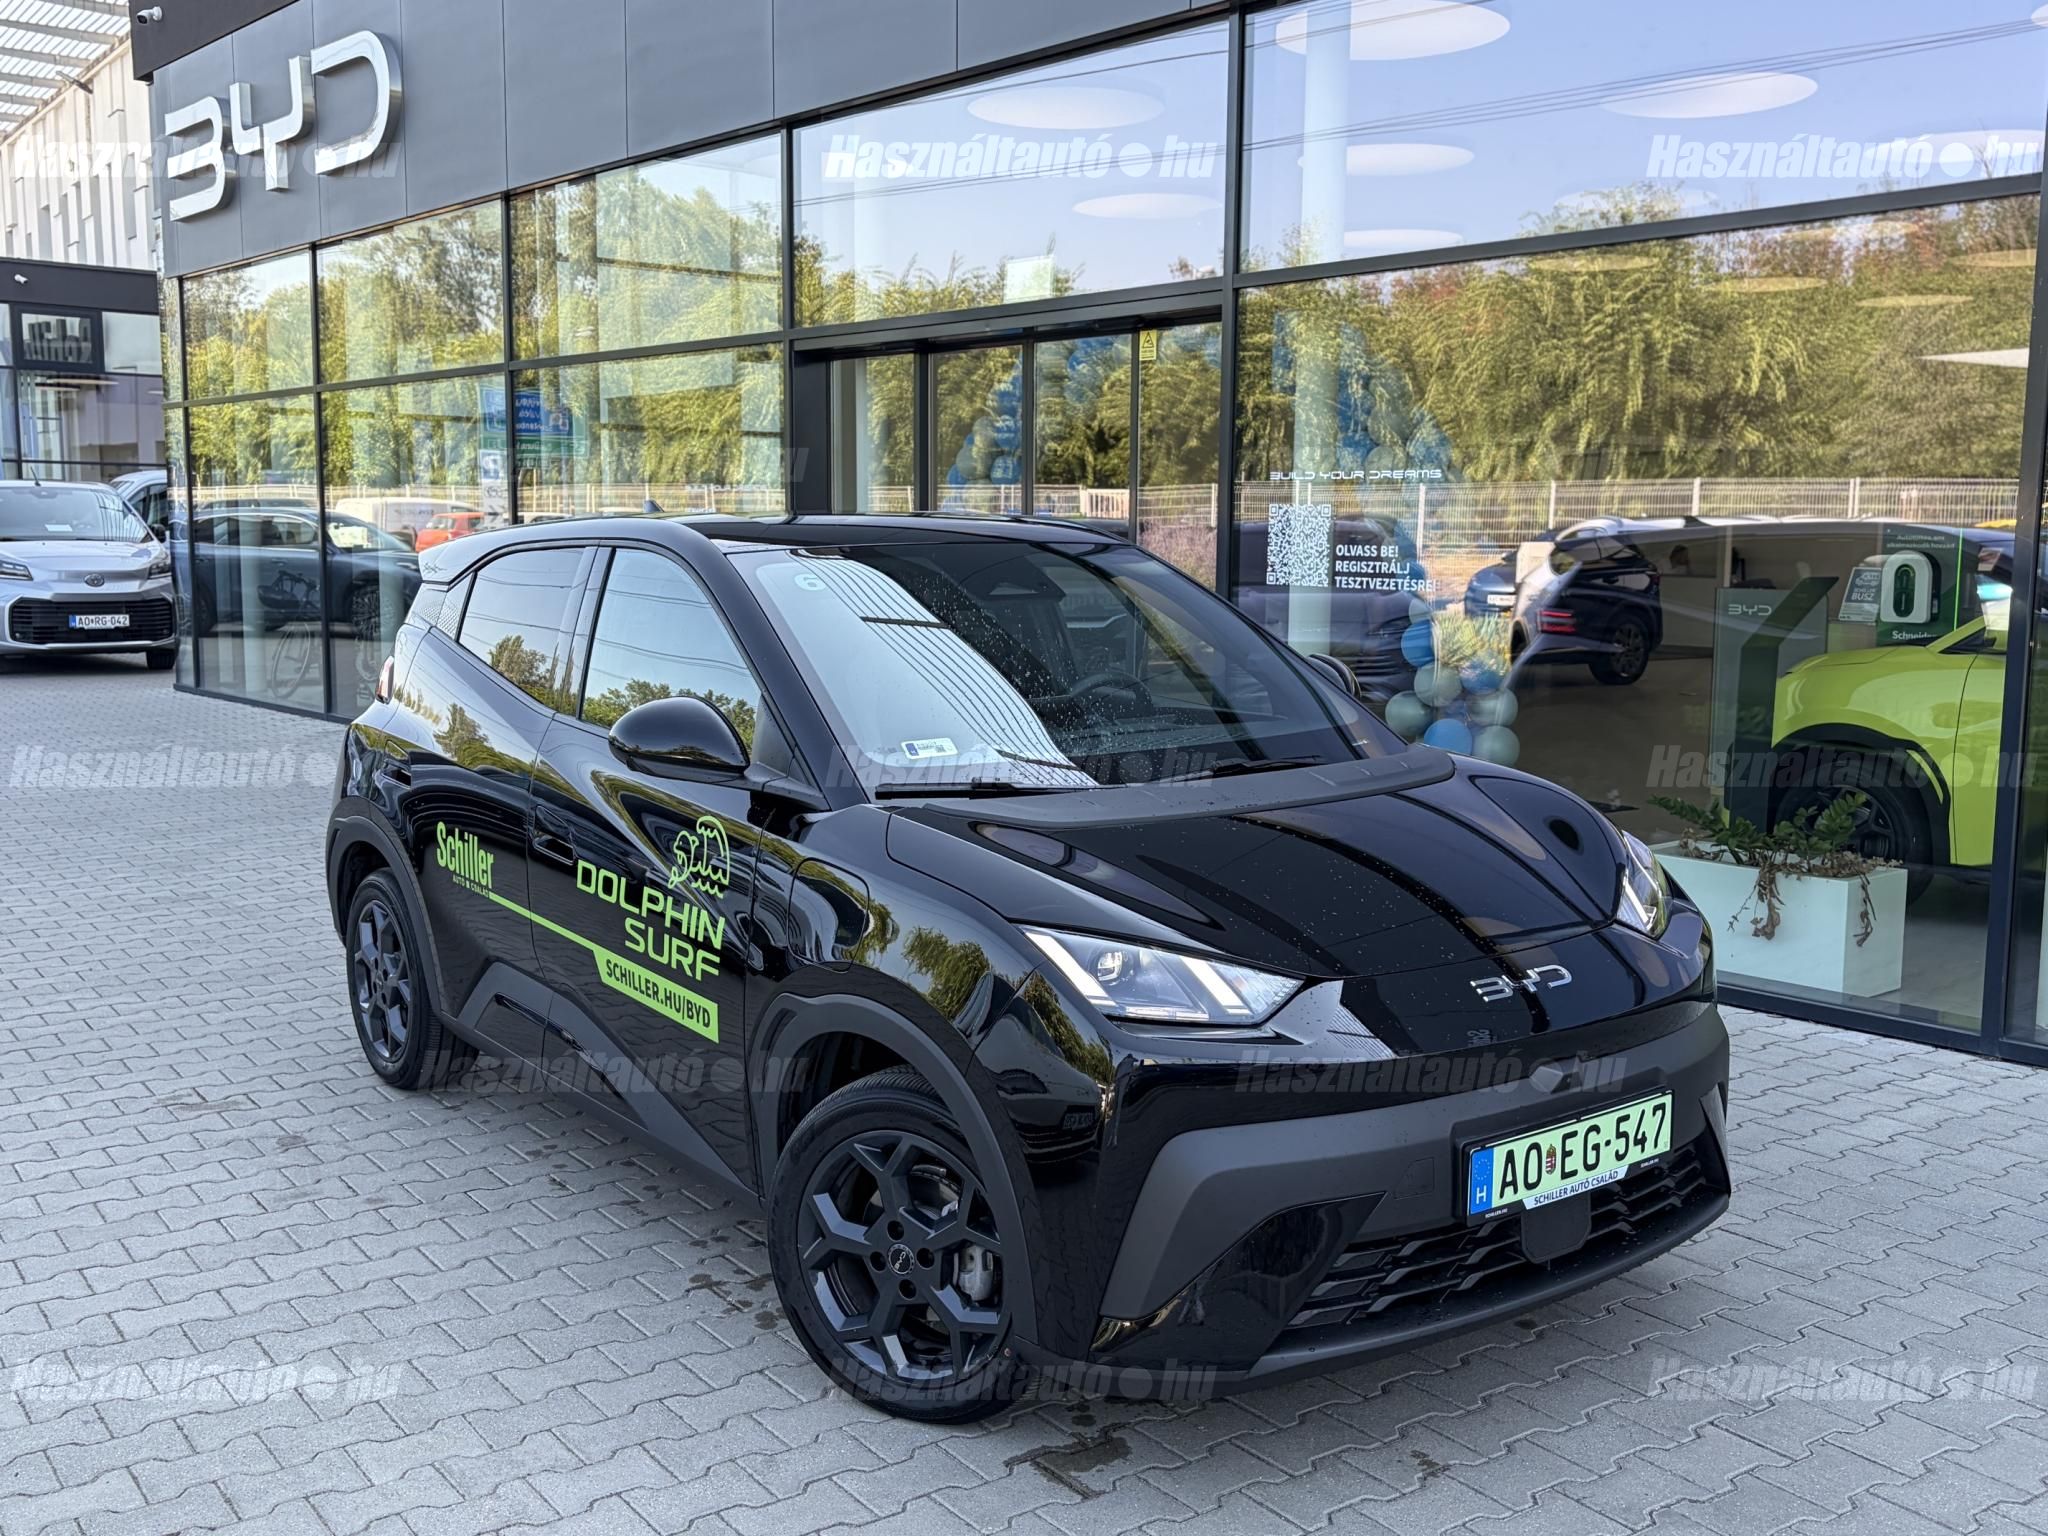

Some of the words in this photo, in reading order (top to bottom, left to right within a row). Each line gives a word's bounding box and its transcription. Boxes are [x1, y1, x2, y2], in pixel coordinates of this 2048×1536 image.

[164, 30, 402, 222] BYD
[1270, 471, 1316, 481] BUILD
[1319, 470, 1365, 480] YOUR
[1368, 469, 1442, 480] DREAMS
[1335, 558, 1411, 575] REGISZTRÁLJ
[1336, 544, 1378, 557] OLVASS
[1380, 545, 1399, 558] BE!
[1727, 602, 1773, 617] BYD
[1851, 592, 1875, 601] BUSZ
[436, 821, 494, 889] Schiller
[576, 859, 726, 950] DOLPHIN
[624, 917, 721, 982] SURF
[605, 958, 711, 1028] SCHILLER.HU/BYD
[1470, 964, 1572, 1002] BYD
[1499, 1141, 1543, 1200] AO
[1560, 1102, 1667, 1181] EG-547
[1476, 1184, 1488, 1206] H
[1533, 1187, 1569, 1206] SCHILLER
[1569, 1179, 1590, 1194] AUTÓ
[1590, 1170, 1619, 1186] CSALÁD
